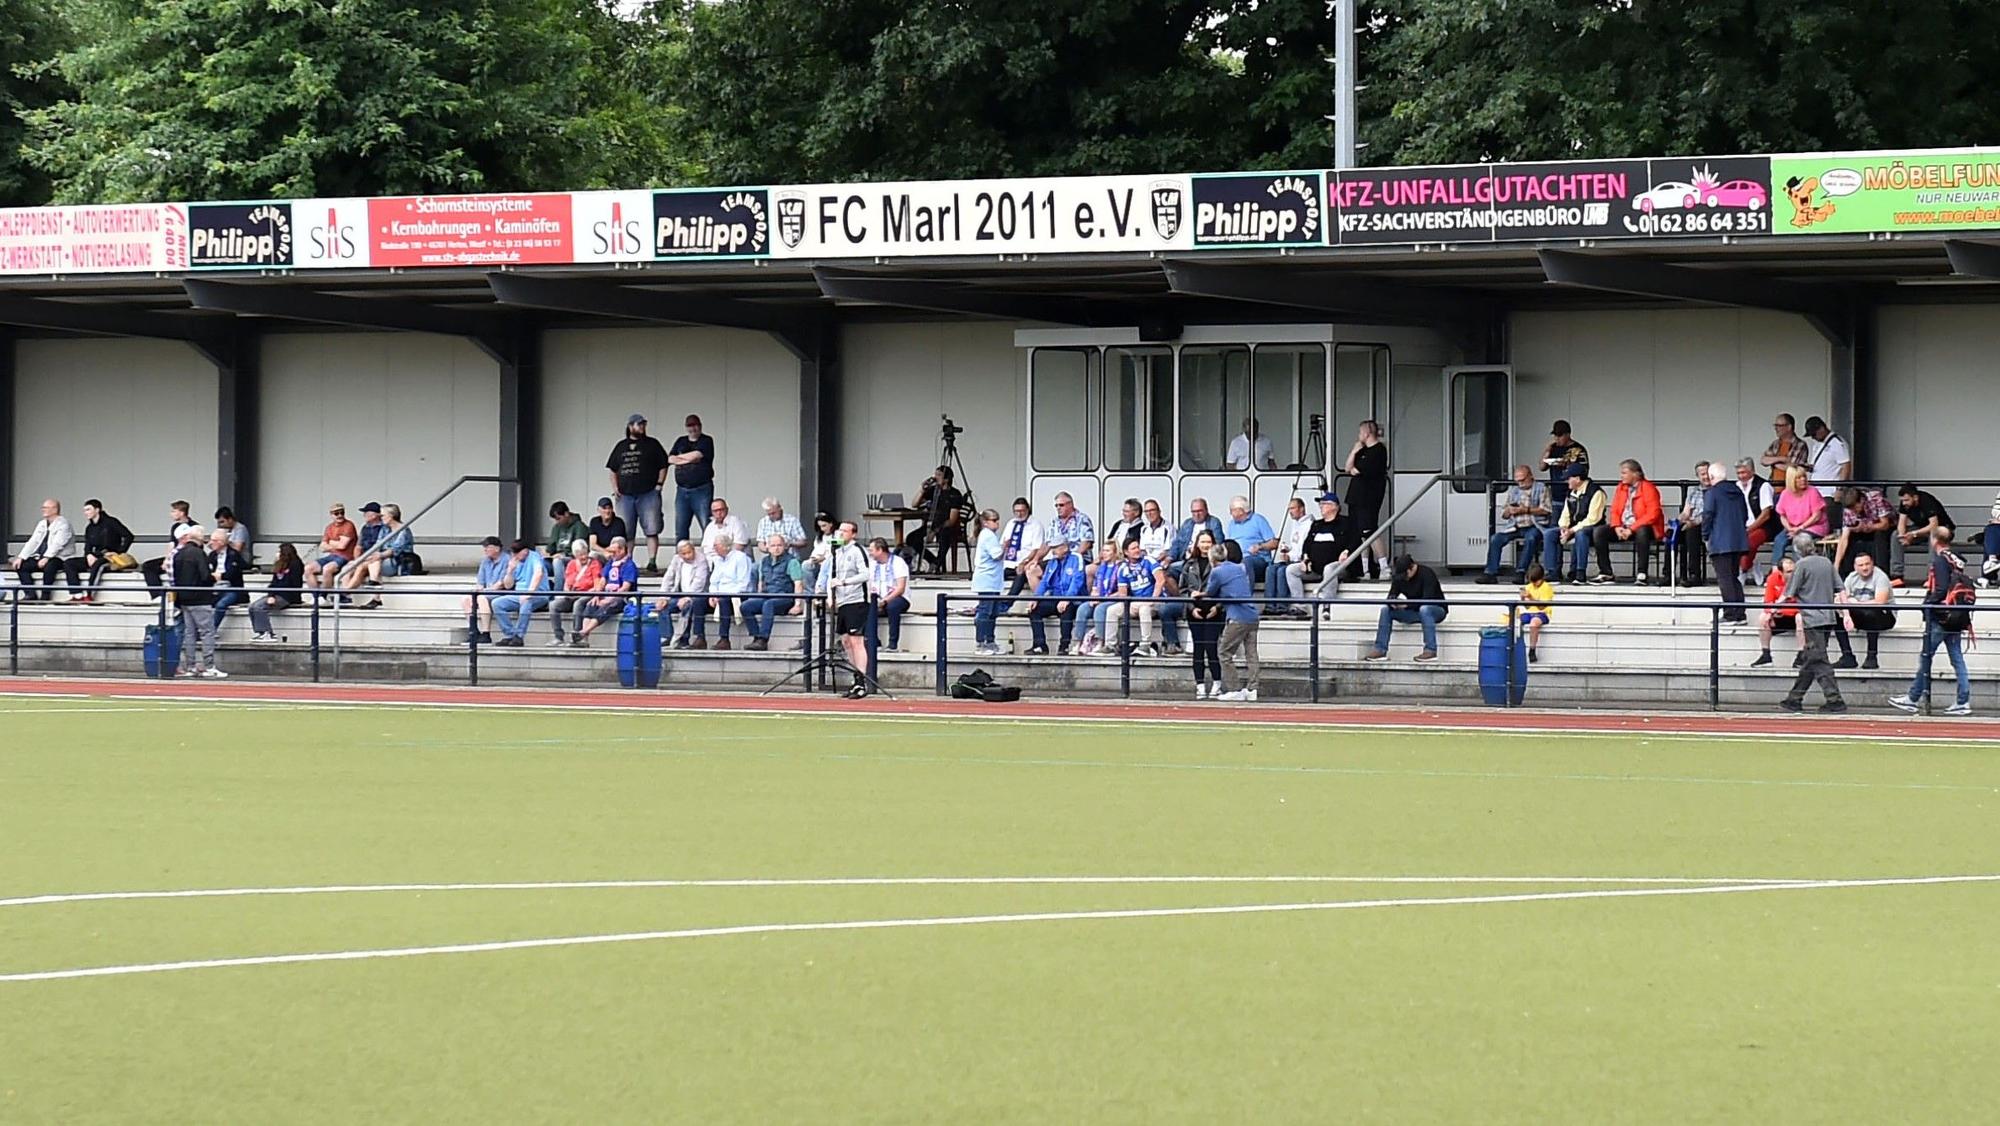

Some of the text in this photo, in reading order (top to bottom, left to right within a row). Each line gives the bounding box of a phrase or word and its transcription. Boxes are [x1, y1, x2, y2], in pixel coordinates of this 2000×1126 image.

[1329, 173, 1626, 208] KFZ-UNFALLGUTACHTEN
[1864, 160, 2000, 190] MÖBELFUN
[416, 198, 533, 215] Schornsteinsysteme
[1267, 176, 1319, 240] TEAMSPORT
[1917, 191, 2000, 204] NUR NEUWAR
[73, 208, 160, 234] AUTOVERWERTUNG
[391, 218, 560, 238] Kernbohrungen Kaminöfen
[720, 192, 768, 252] TEAMSPORT
[819, 188, 1141, 243] FC Marl 2011 e.V.
[1196, 202, 1297, 241] Philipp
[1341, 204, 1581, 232] KFZ-SACHVERSTÄNDIGENBÜRO
[1639, 211, 1767, 233] 0162 86 64 351
[192, 228, 272, 263] Philipp
[248, 205, 291, 262] TEAMSPORT
[656, 216, 748, 253] Philipp
[72, 242, 152, 268] NOTVERGLASUNG
